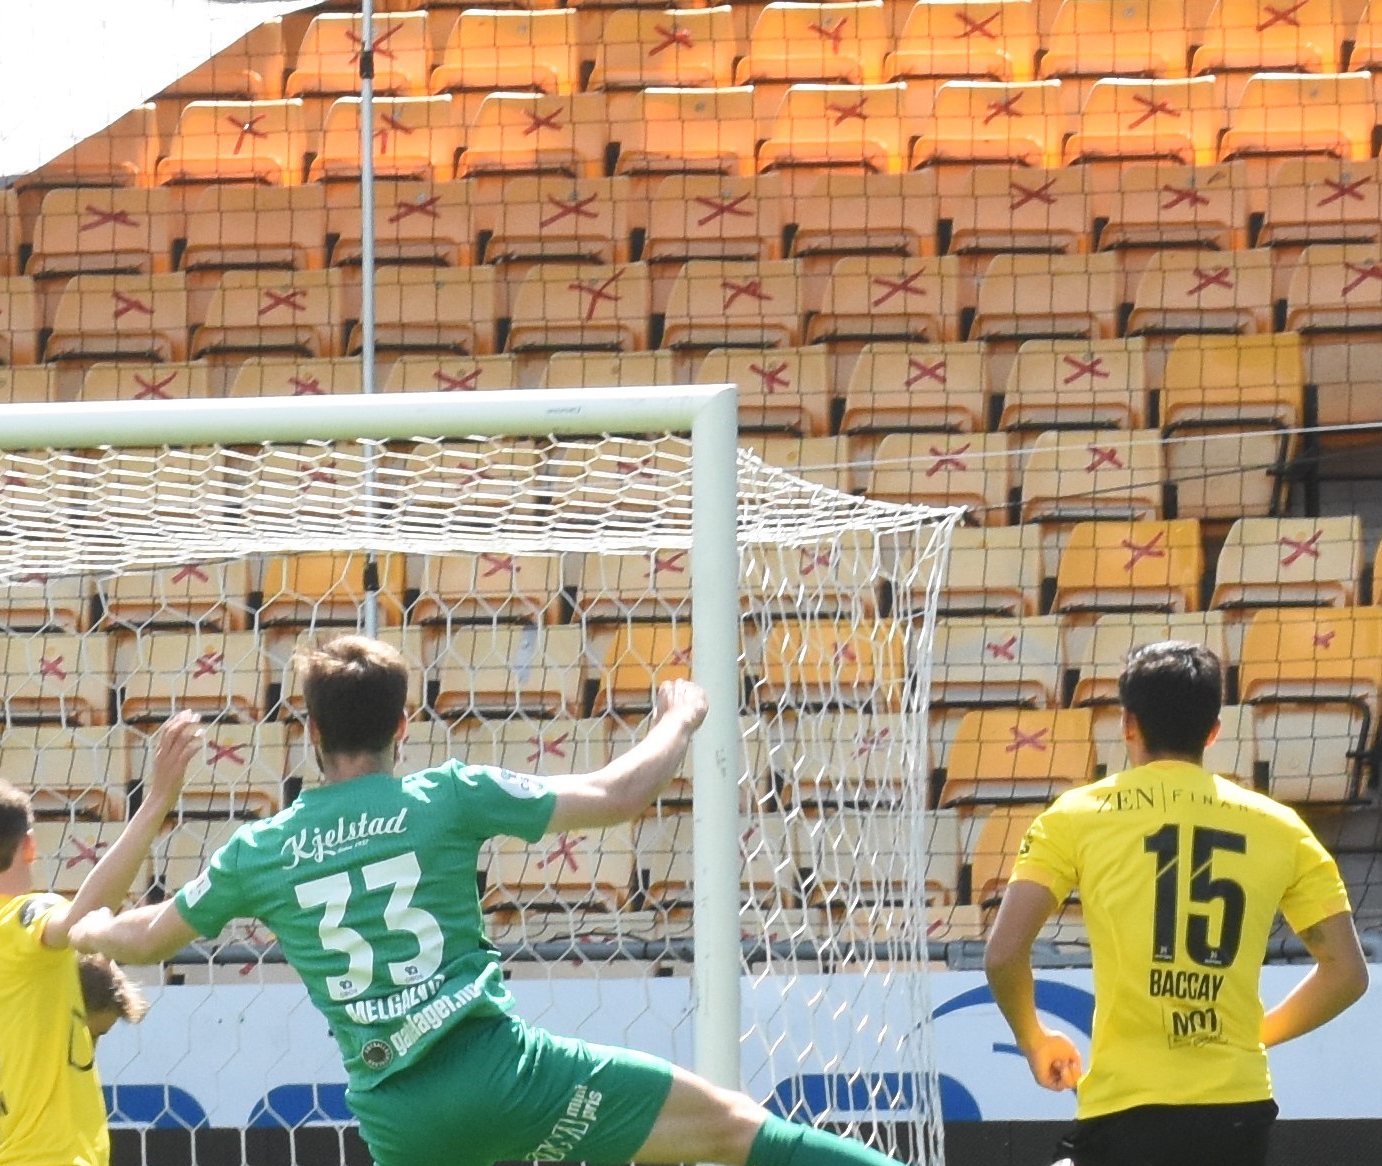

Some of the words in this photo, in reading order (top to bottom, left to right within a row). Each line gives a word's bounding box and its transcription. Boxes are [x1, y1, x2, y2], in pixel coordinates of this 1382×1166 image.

[1096, 787, 1155, 814] ZEN
[280, 807, 408, 870] Kjelstad
[294, 850, 445, 1000] 33
[1143, 823, 1247, 968] 15
[1148, 968, 1225, 1002] BACCAY
